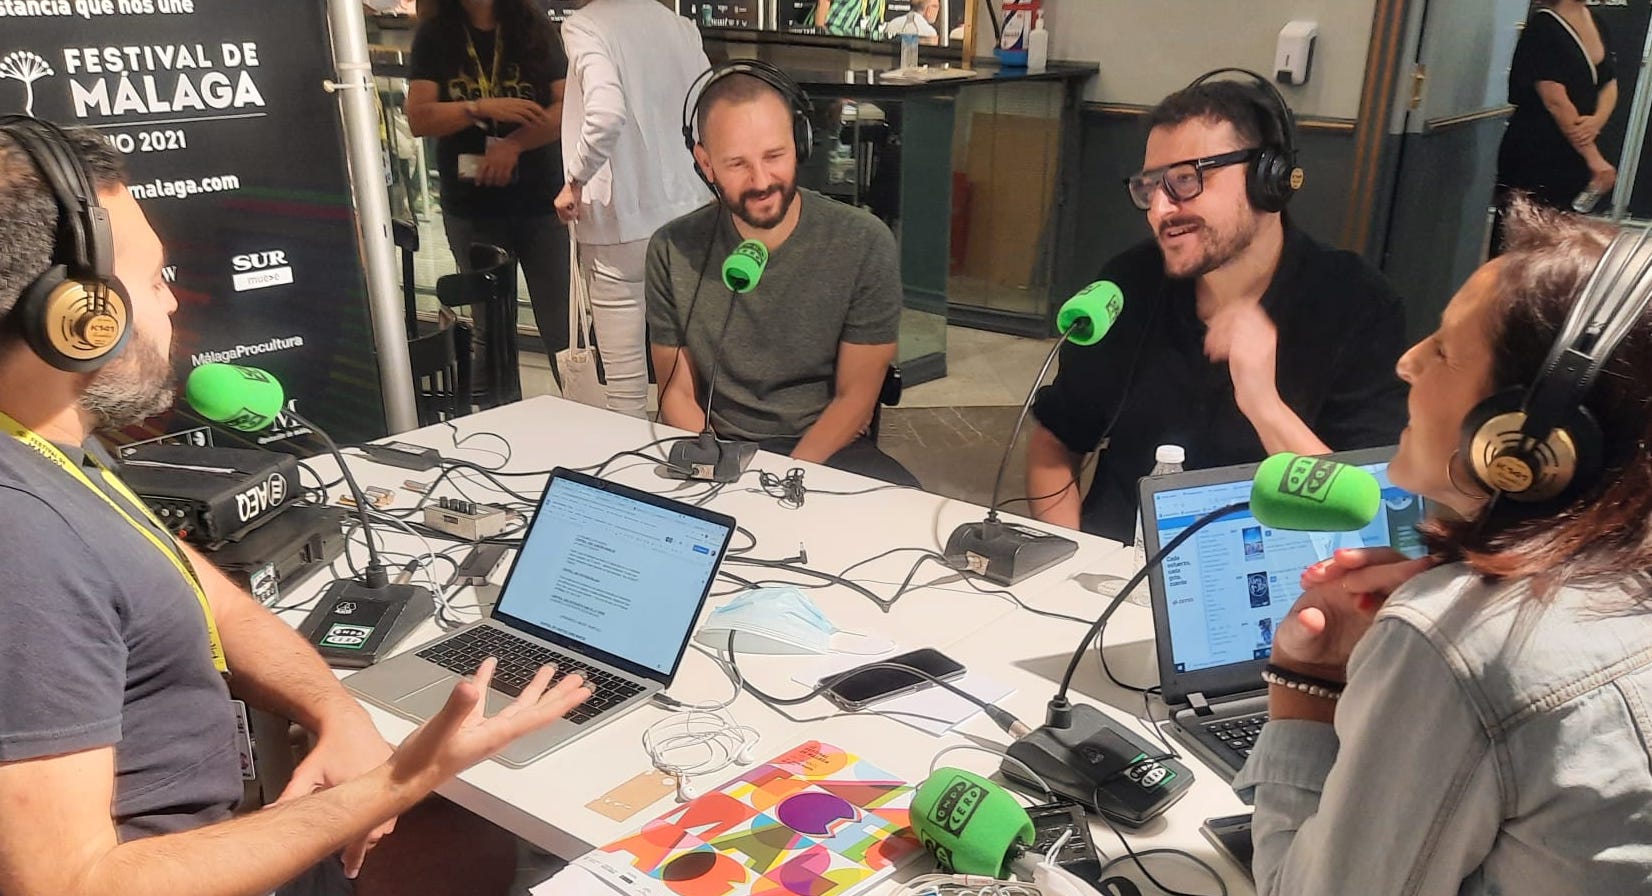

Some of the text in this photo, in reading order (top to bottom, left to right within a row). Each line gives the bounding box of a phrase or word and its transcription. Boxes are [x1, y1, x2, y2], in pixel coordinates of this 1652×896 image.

[75, 0, 114, 20] que
[119, 0, 155, 14] nos
[158, 0, 195, 14] une
[63, 43, 260, 75] FESTIVAL DE
[69, 69, 266, 119] MÁLAGA
[138, 129, 187, 152] 2021
[232, 250, 289, 271] SUR
[236, 482, 267, 521] AEQ
[937, 783, 967, 818] ONDA
[951, 790, 977, 824] CERO
